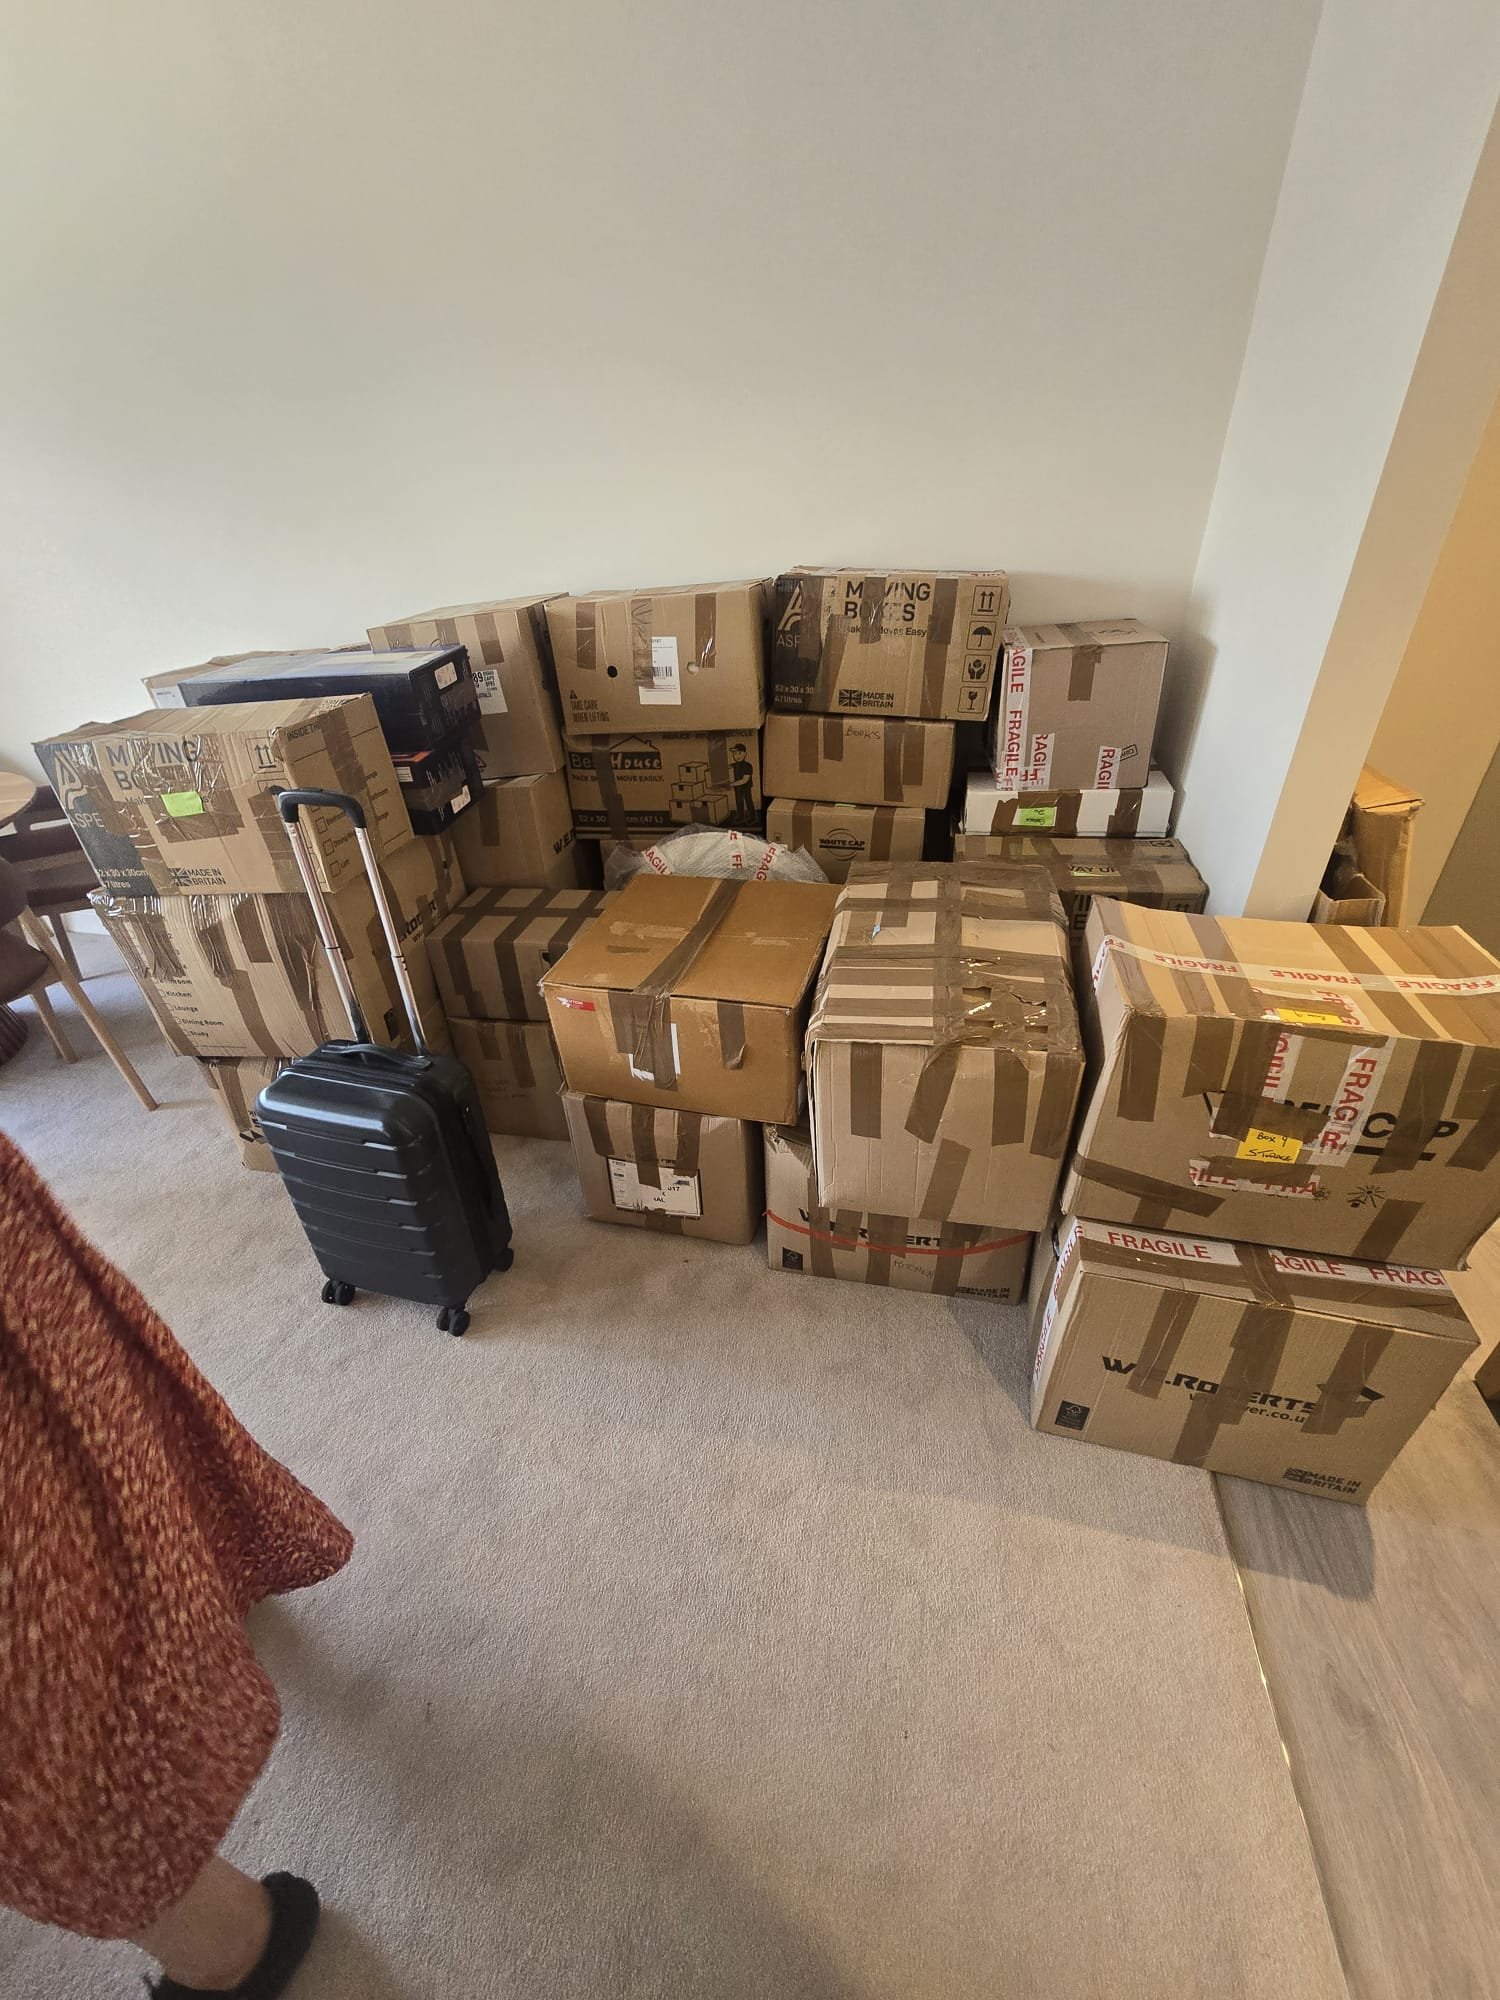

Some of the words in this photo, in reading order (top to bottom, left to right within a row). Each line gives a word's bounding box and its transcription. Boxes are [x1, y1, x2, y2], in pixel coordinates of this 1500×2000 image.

[846, 581, 931, 601] MVING
[1011, 646, 1026, 693] AGILE
[862, 700, 894, 708] BRITAIN
[863, 692, 885, 701] MADE
[886, 692, 895, 701] IN
[1006, 710, 1022, 777] FRAGILE
[819, 838, 847, 847] WHITE
[848, 840, 866, 848] CAP
[187, 868, 210, 877] MADE
[211, 868, 222, 876] IN
[191, 877, 227, 886] BRITAIN
[1361, 1112, 1460, 1139] CP
[1108, 1231, 1212, 1259] FRAGILE
[1271, 1254, 1346, 1277] AGILE
[1367, 1268, 1445, 1286] FRAG
[1304, 1478, 1359, 1494] BRITAIN
[1307, 1471, 1345, 1484] MADE
[1346, 1479, 1361, 1488] IN
